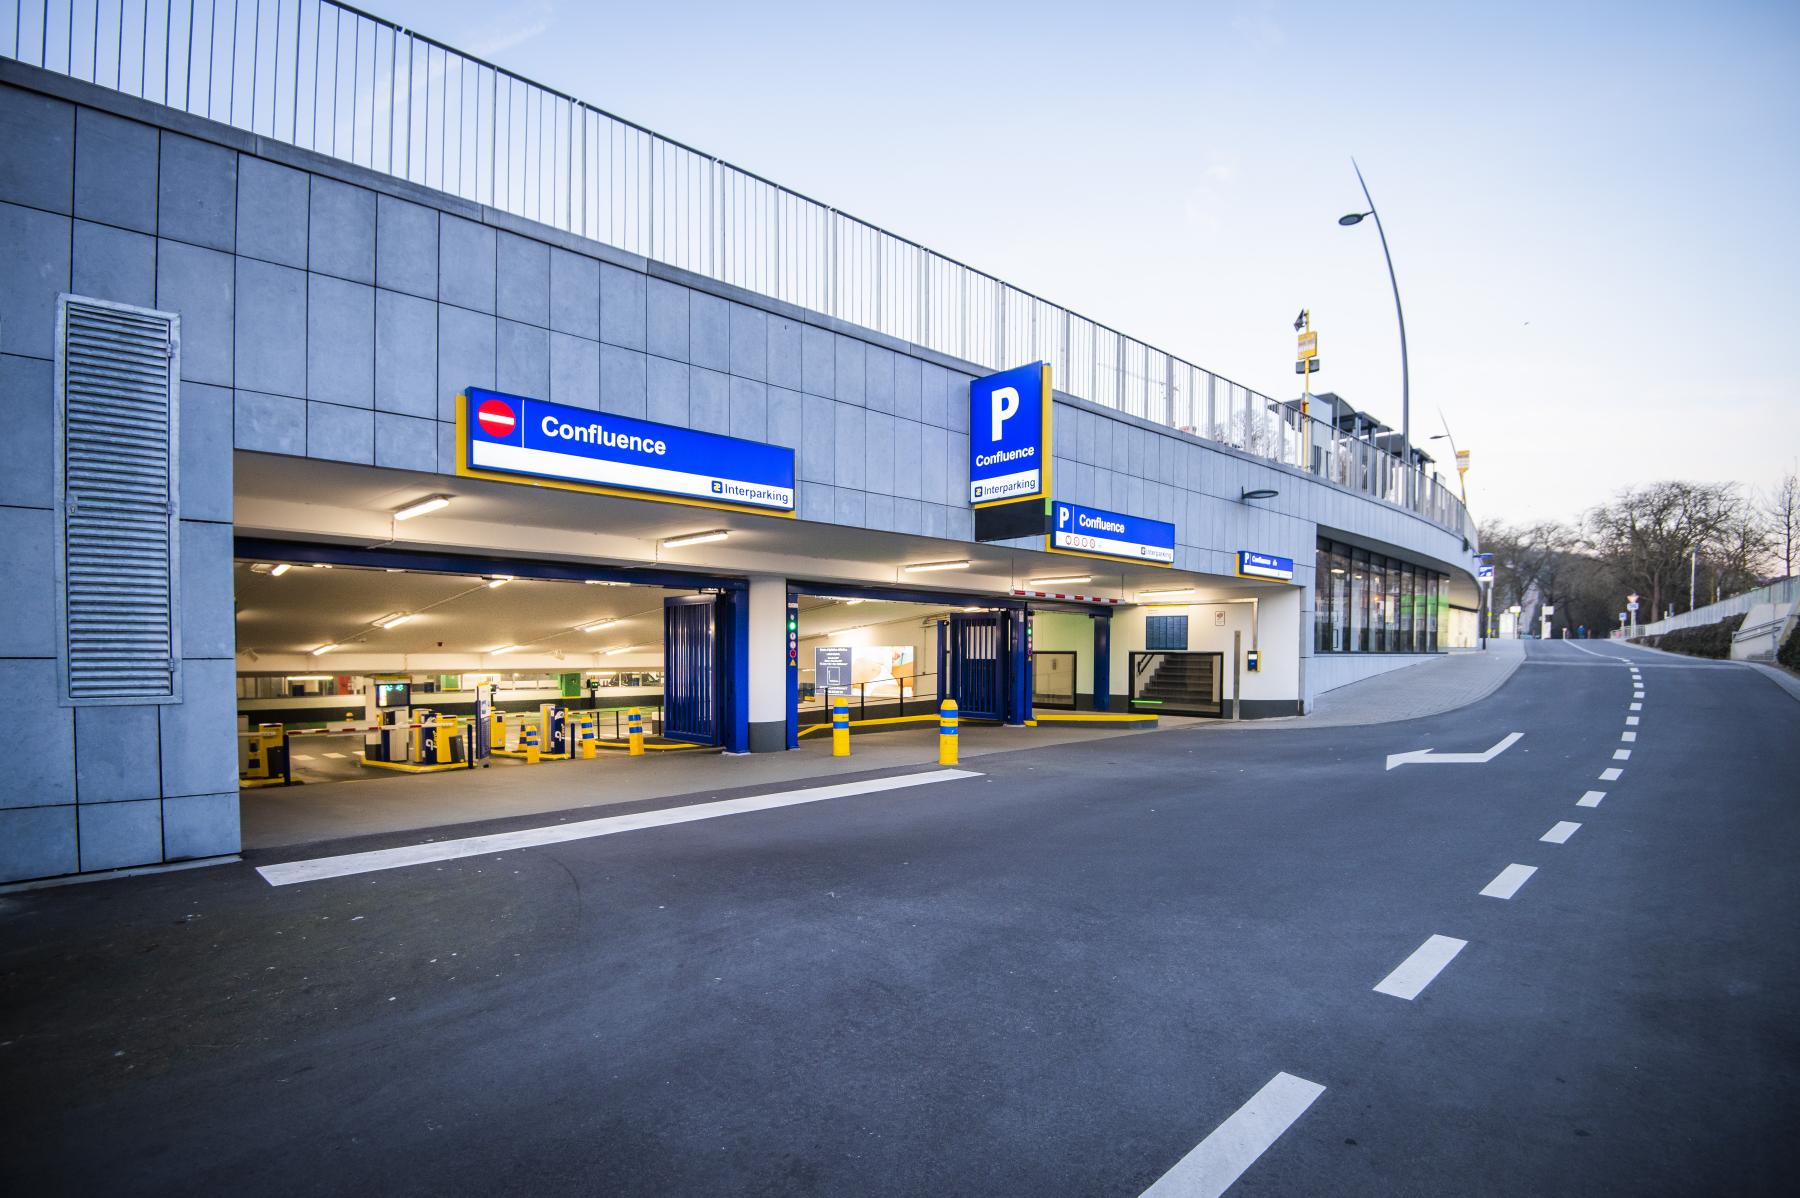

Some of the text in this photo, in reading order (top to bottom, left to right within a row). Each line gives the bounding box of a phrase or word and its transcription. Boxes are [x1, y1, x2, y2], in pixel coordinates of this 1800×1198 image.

[992, 386, 1019, 441] P
[541, 416, 666, 455] Confluence
[976, 446, 1035, 467] Confluence
[725, 483, 789, 504] Interparking
[984, 480, 1036, 496] Interparking
[1060, 507, 1125, 533] P Confluence
